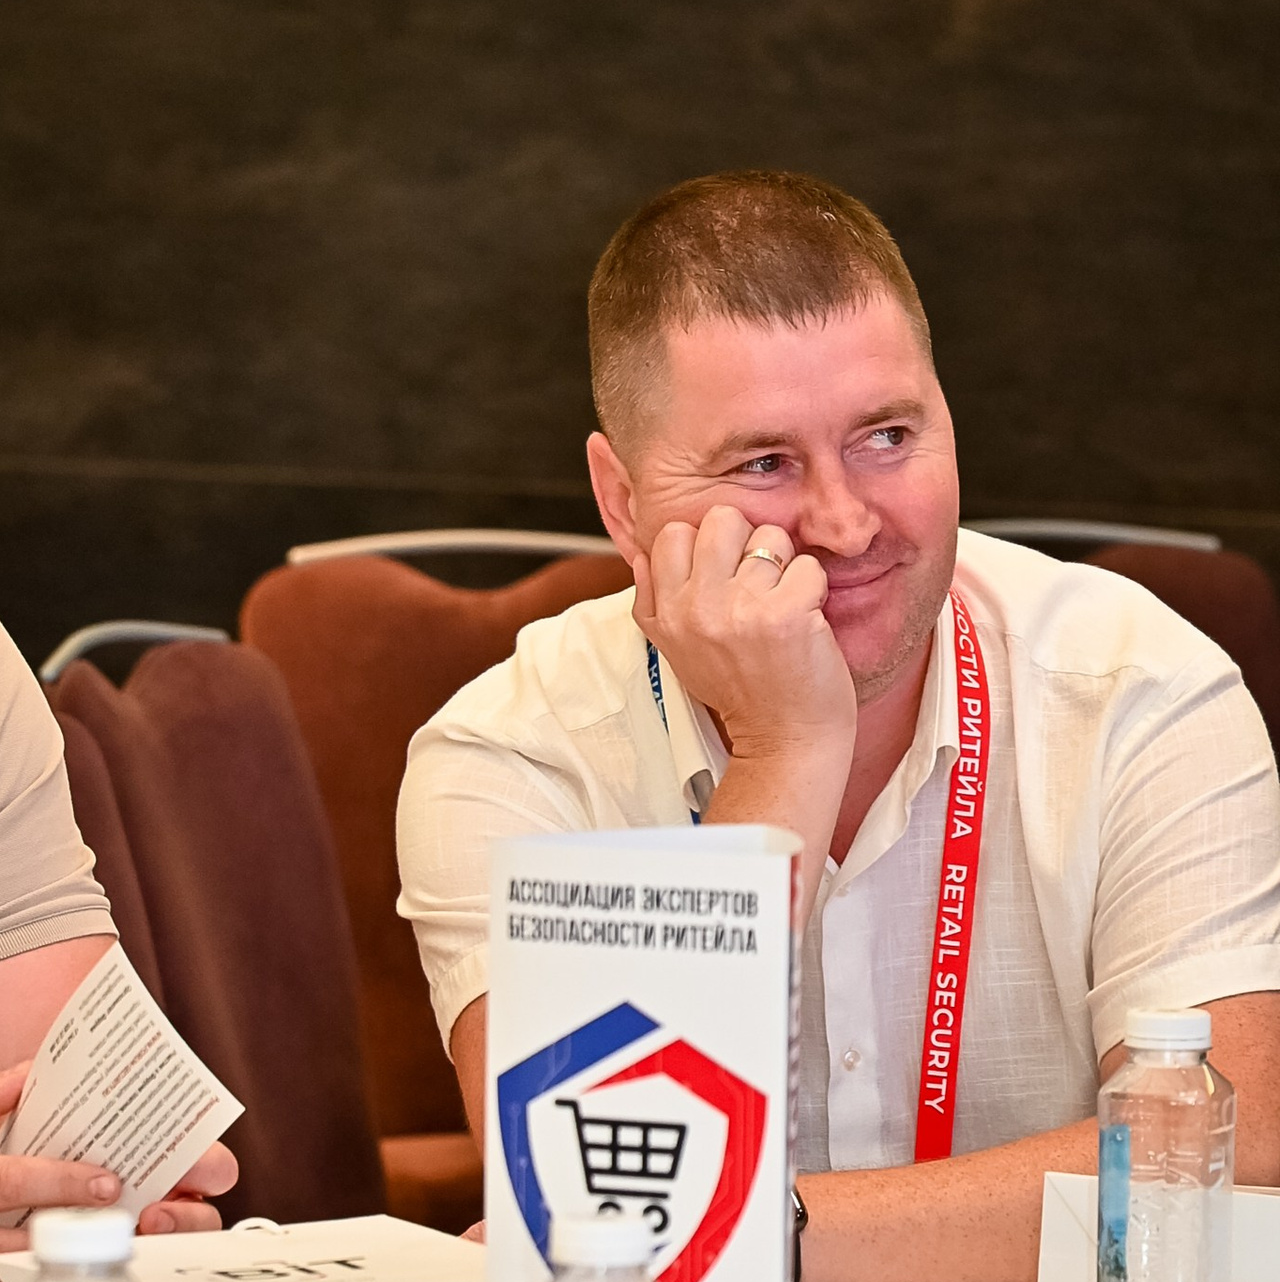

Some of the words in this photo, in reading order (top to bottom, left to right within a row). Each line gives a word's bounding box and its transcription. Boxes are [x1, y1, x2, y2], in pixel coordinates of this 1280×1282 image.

[950, 697, 983, 839] РИТЕЙЛА
[508, 878, 637, 912] АССОЦИАЦИЯ
[642, 886, 759, 919] ЭКСПЕРТОВ
[508, 913, 657, 950] БЕЗОПАСНОСТИ
[661, 922, 758, 955] РИТЕЙЛА
[938, 864, 968, 964] RETAIL
[924, 971, 958, 1115] SECURITY
